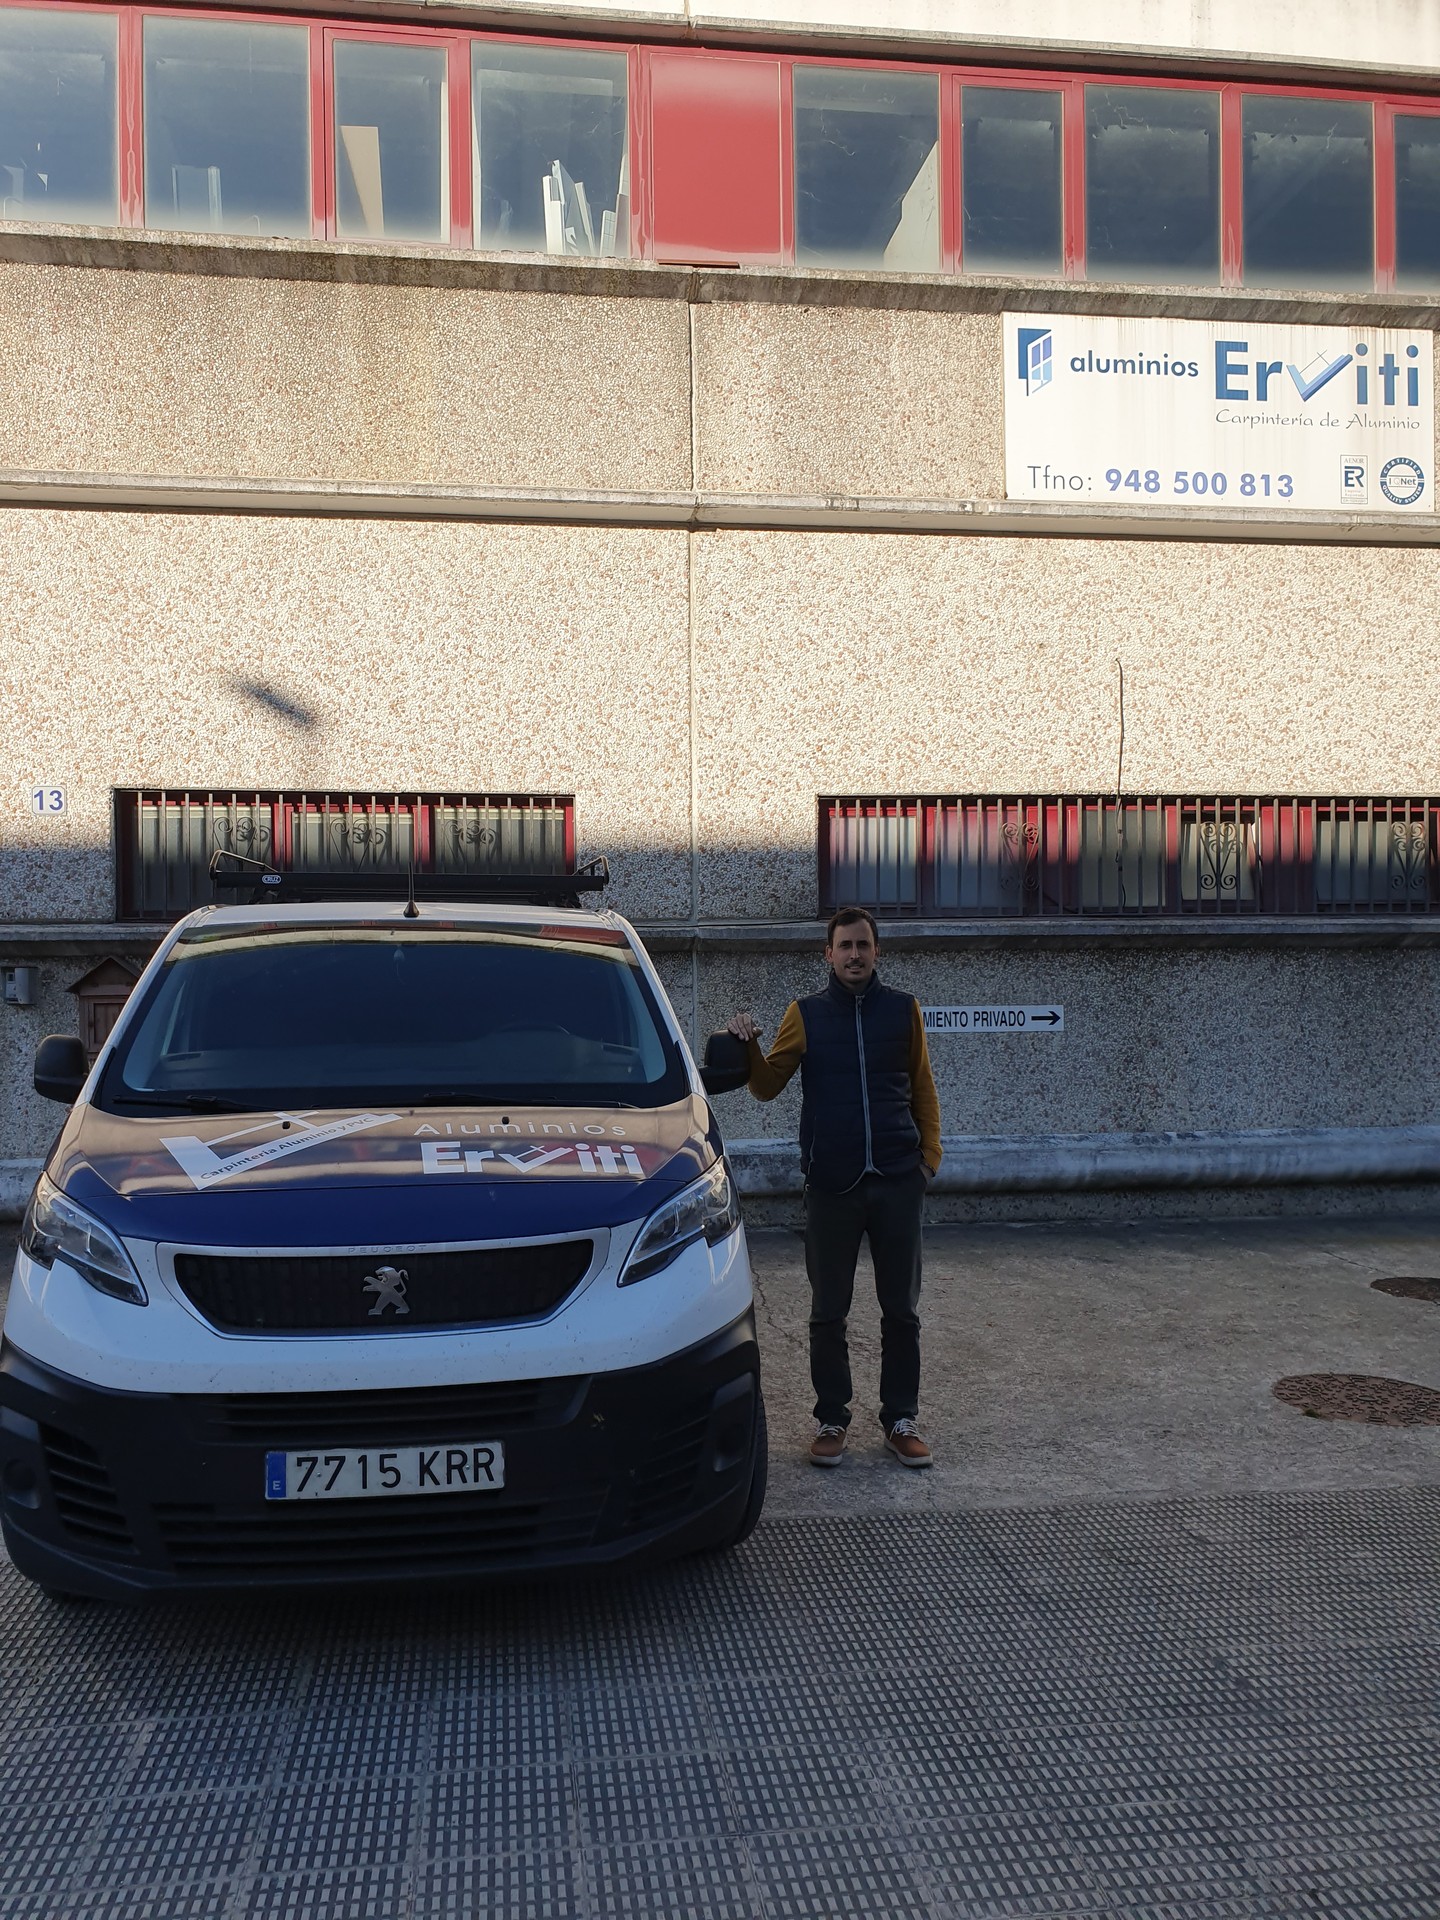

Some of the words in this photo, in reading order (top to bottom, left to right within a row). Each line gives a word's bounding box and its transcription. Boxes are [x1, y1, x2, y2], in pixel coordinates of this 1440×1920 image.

[1070, 350, 1199, 378] aluminios
[1214, 340, 1420, 407] Erviti
[1215, 409, 1314, 430] Carpintería
[1319, 412, 1340, 428] de
[1346, 413, 1421, 431] Aluminio
[1383, 458, 1421, 474] CERTIFIED
[1027, 465, 1093, 491] Tfno:
[1105, 468, 1161, 493] 948
[1173, 471, 1228, 496] 500
[1239, 473, 1294, 498] 813
[1382, 485, 1403, 504] QUALITY
[34, 790, 63, 811] 13
[973, 1010, 1026, 1028] PRIVADO
[279, 1128, 336, 1151] Aluminio
[348, 1117, 374, 1128] PVC
[413, 1122, 626, 1136] Aluminios
[348, 1245, 427, 1254] PEUGEOT
[296, 1454, 402, 1492] 7715
[418, 1448, 495, 1487] KRR
[272, 1480, 281, 1491] E
